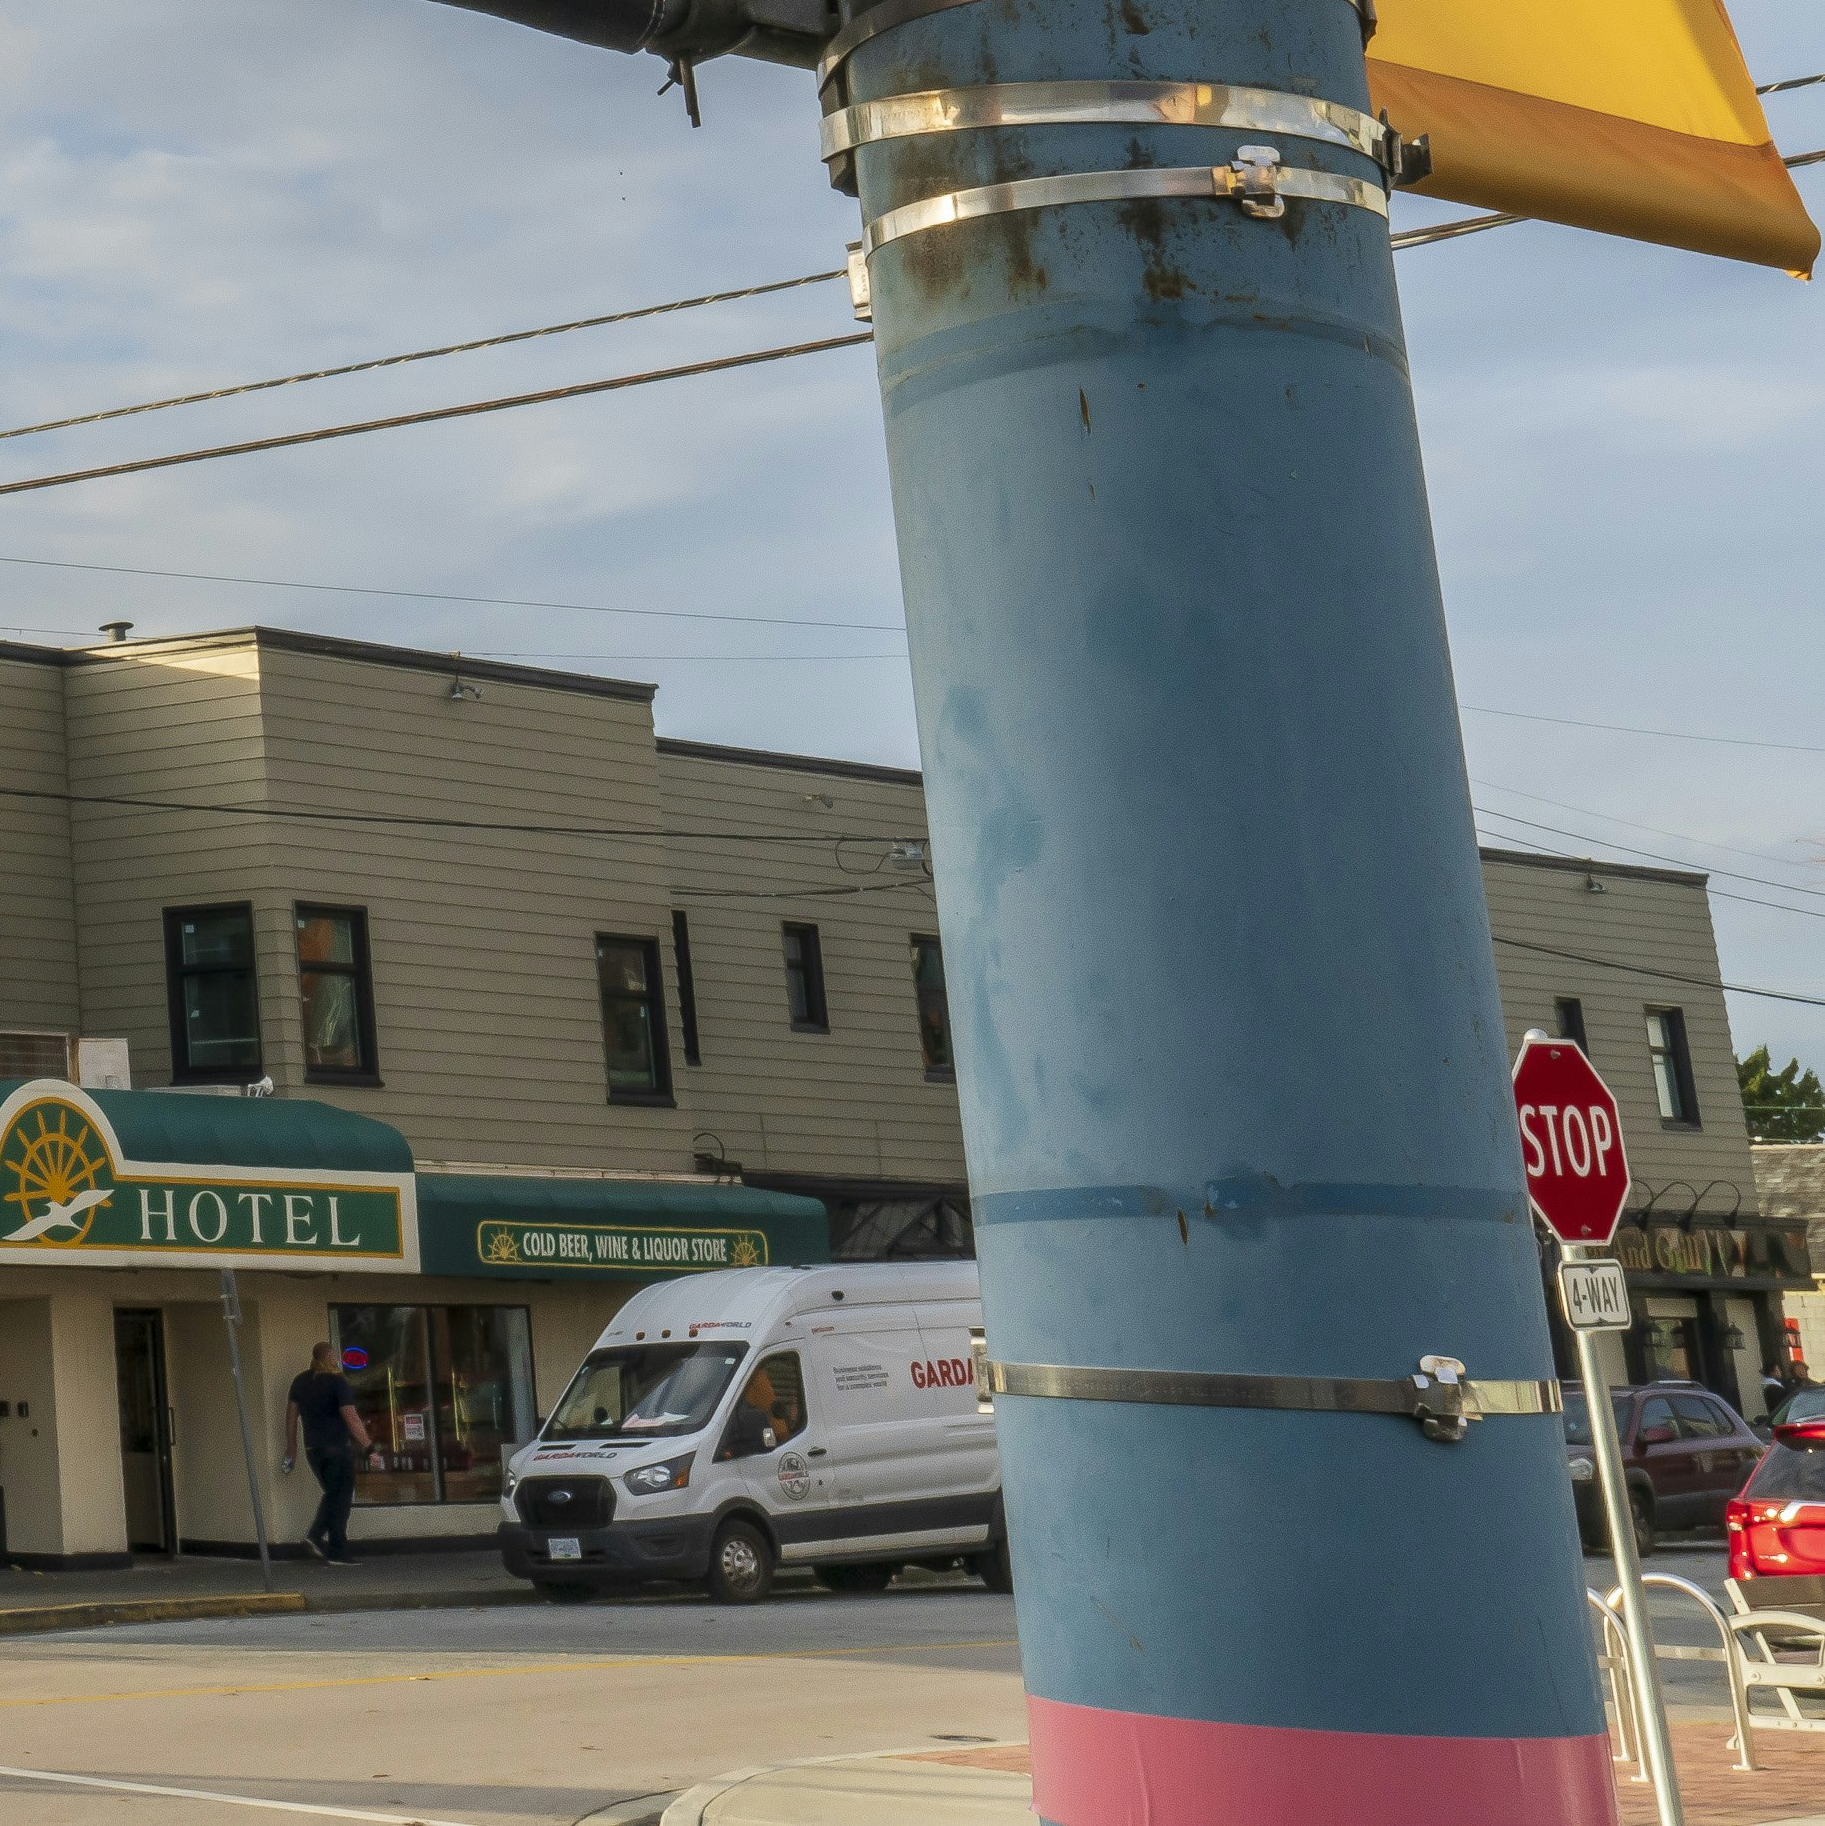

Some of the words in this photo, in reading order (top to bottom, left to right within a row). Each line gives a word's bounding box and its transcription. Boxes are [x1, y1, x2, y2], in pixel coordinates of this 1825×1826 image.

[1519, 1104, 1612, 1177] STOP
[138, 1188, 362, 1247] HOTEL
[523, 1232, 555, 1257] COLD
[558, 1233, 593, 1262] BEER,
[595, 1234, 629, 1260] WINE
[632, 1237, 641, 1260] &
[643, 1237, 690, 1262] LIQUOR
[691, 1238, 727, 1262] STORE
[1613, 1227, 1652, 1269] And
[1572, 1276, 1620, 1314] 4-WAY
